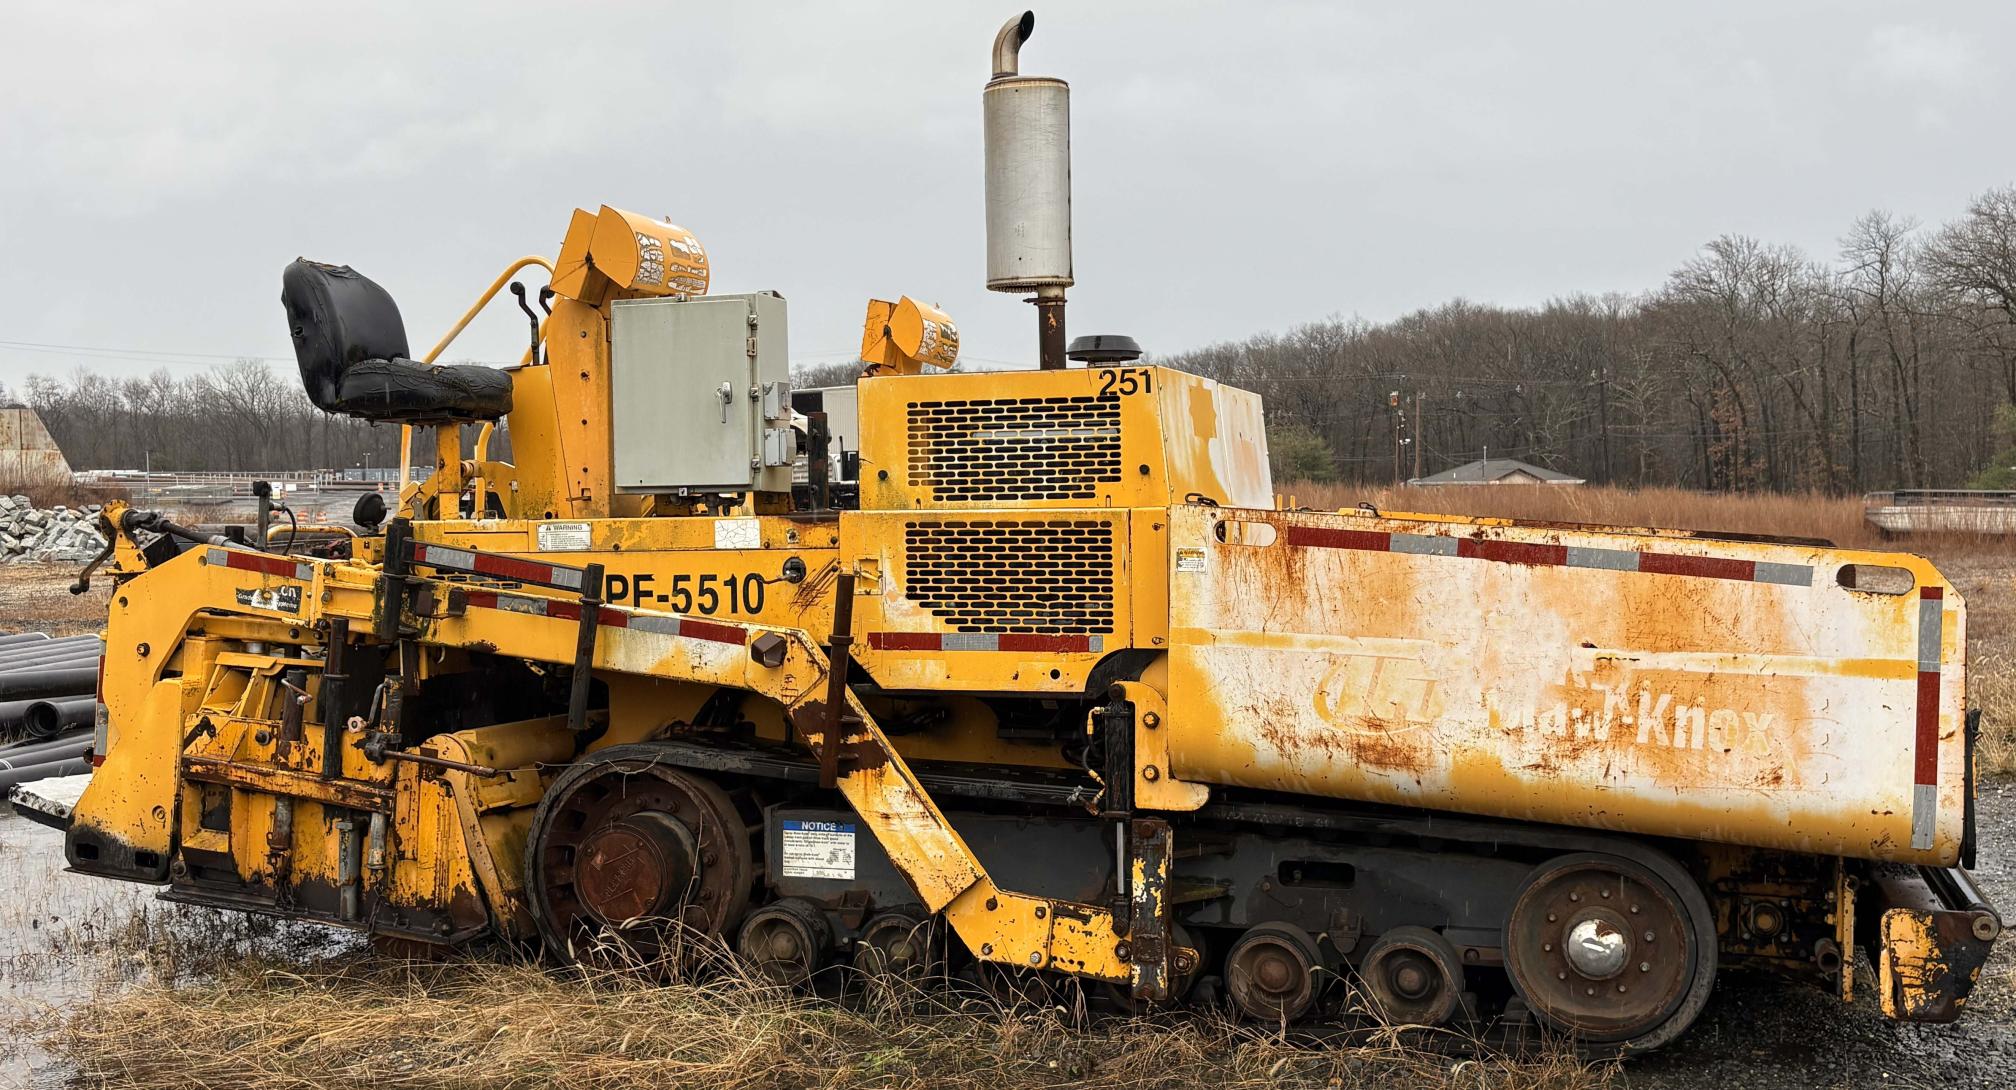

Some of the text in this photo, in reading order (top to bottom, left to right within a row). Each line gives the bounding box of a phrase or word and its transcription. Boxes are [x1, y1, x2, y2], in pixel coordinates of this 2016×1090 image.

[1099, 368, 1151, 396] 251
[606, 573, 764, 614] PF-5510
[801, 821, 837, 831] NOTICE
